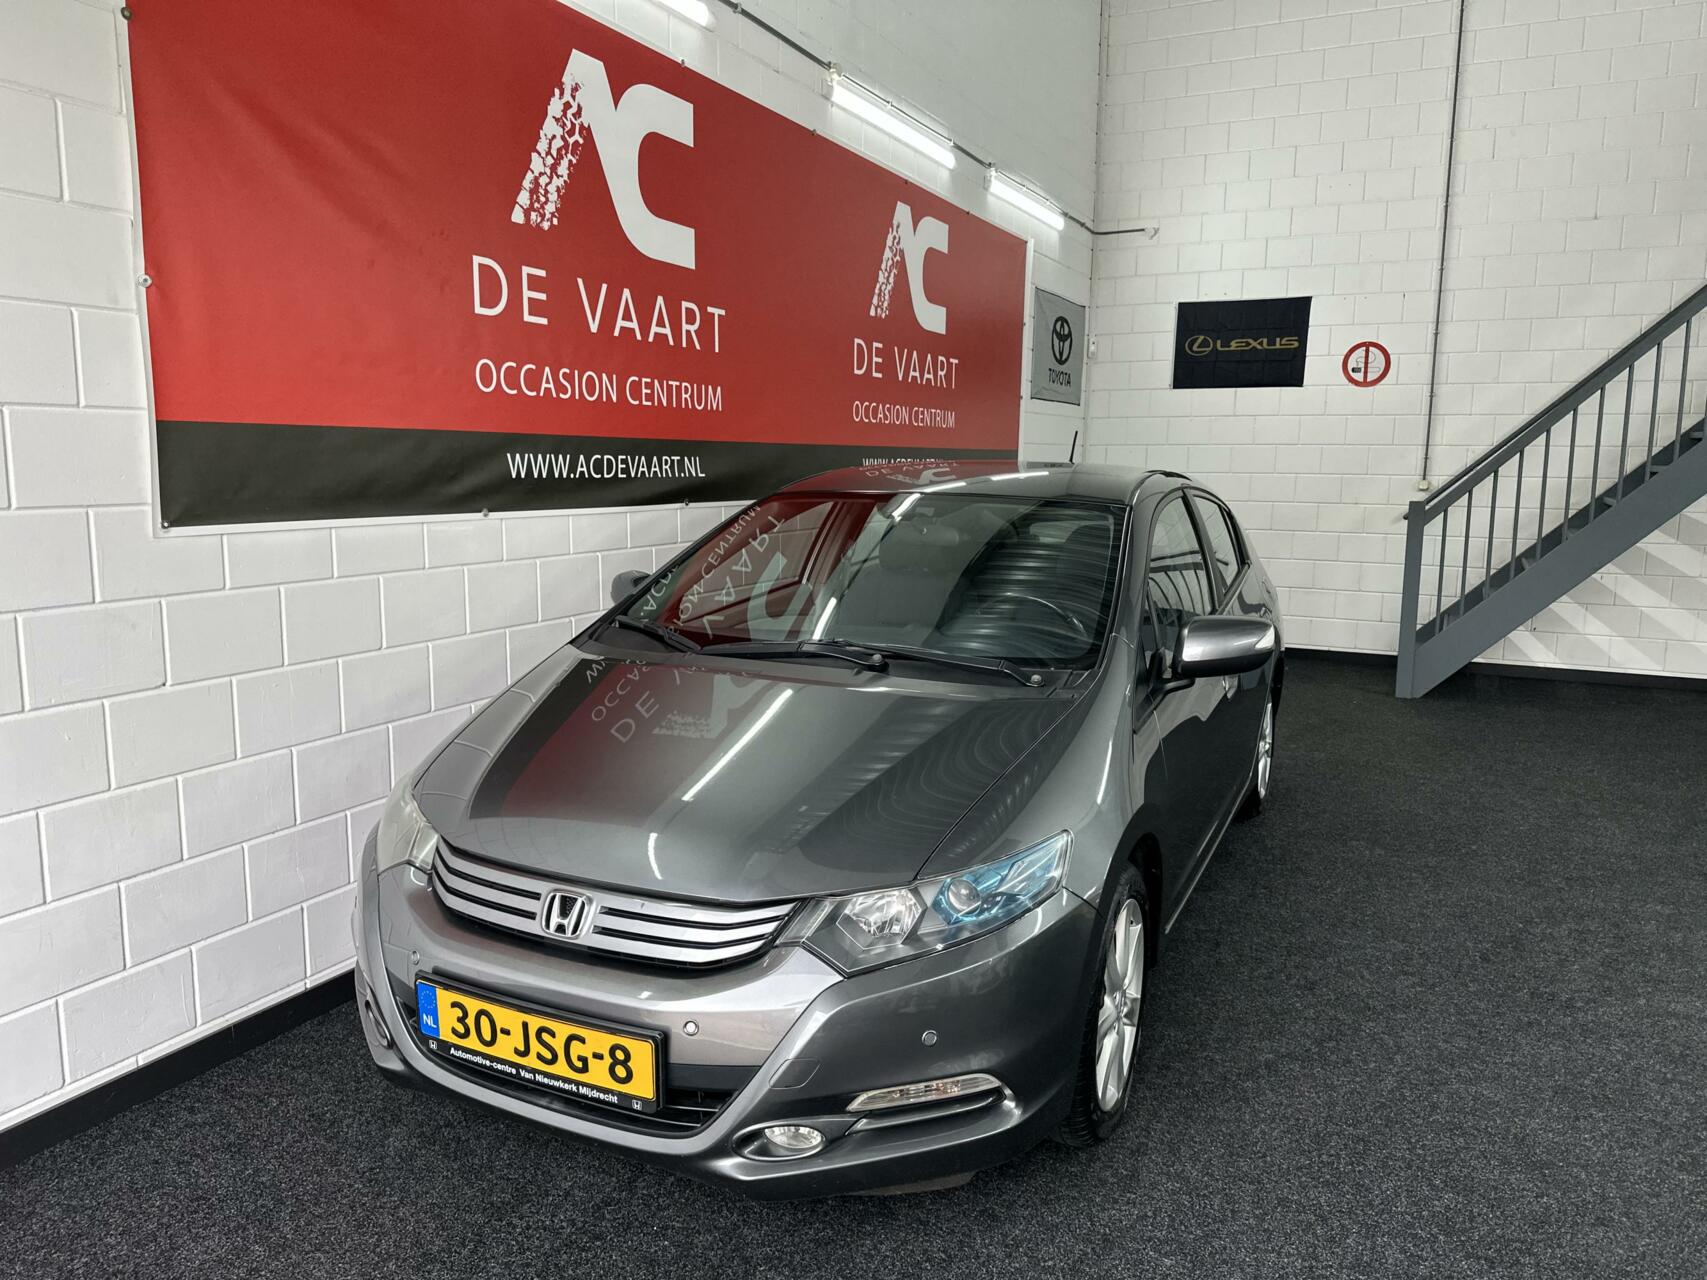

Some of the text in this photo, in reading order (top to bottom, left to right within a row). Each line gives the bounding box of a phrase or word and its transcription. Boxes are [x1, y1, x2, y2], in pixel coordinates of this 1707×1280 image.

[472, 254, 726, 353] DE VAART
[853, 337, 959, 389] DE VAART
[1216, 336, 1300, 351] LEXUS
[475, 358, 722, 411] OCCASION CENTRUM
[1048, 367, 1071, 388] TOYOTA
[852, 400, 955, 428] OCCASION CENTRUM
[506, 452, 706, 480] WWW.ACDEVAART.NL
[422, 1013, 437, 1028] NL
[450, 1001, 634, 1085] 30-JSG-8
[449, 1047, 619, 1104] Automotive-centre Van Nieuwkerk Mijdrecht
